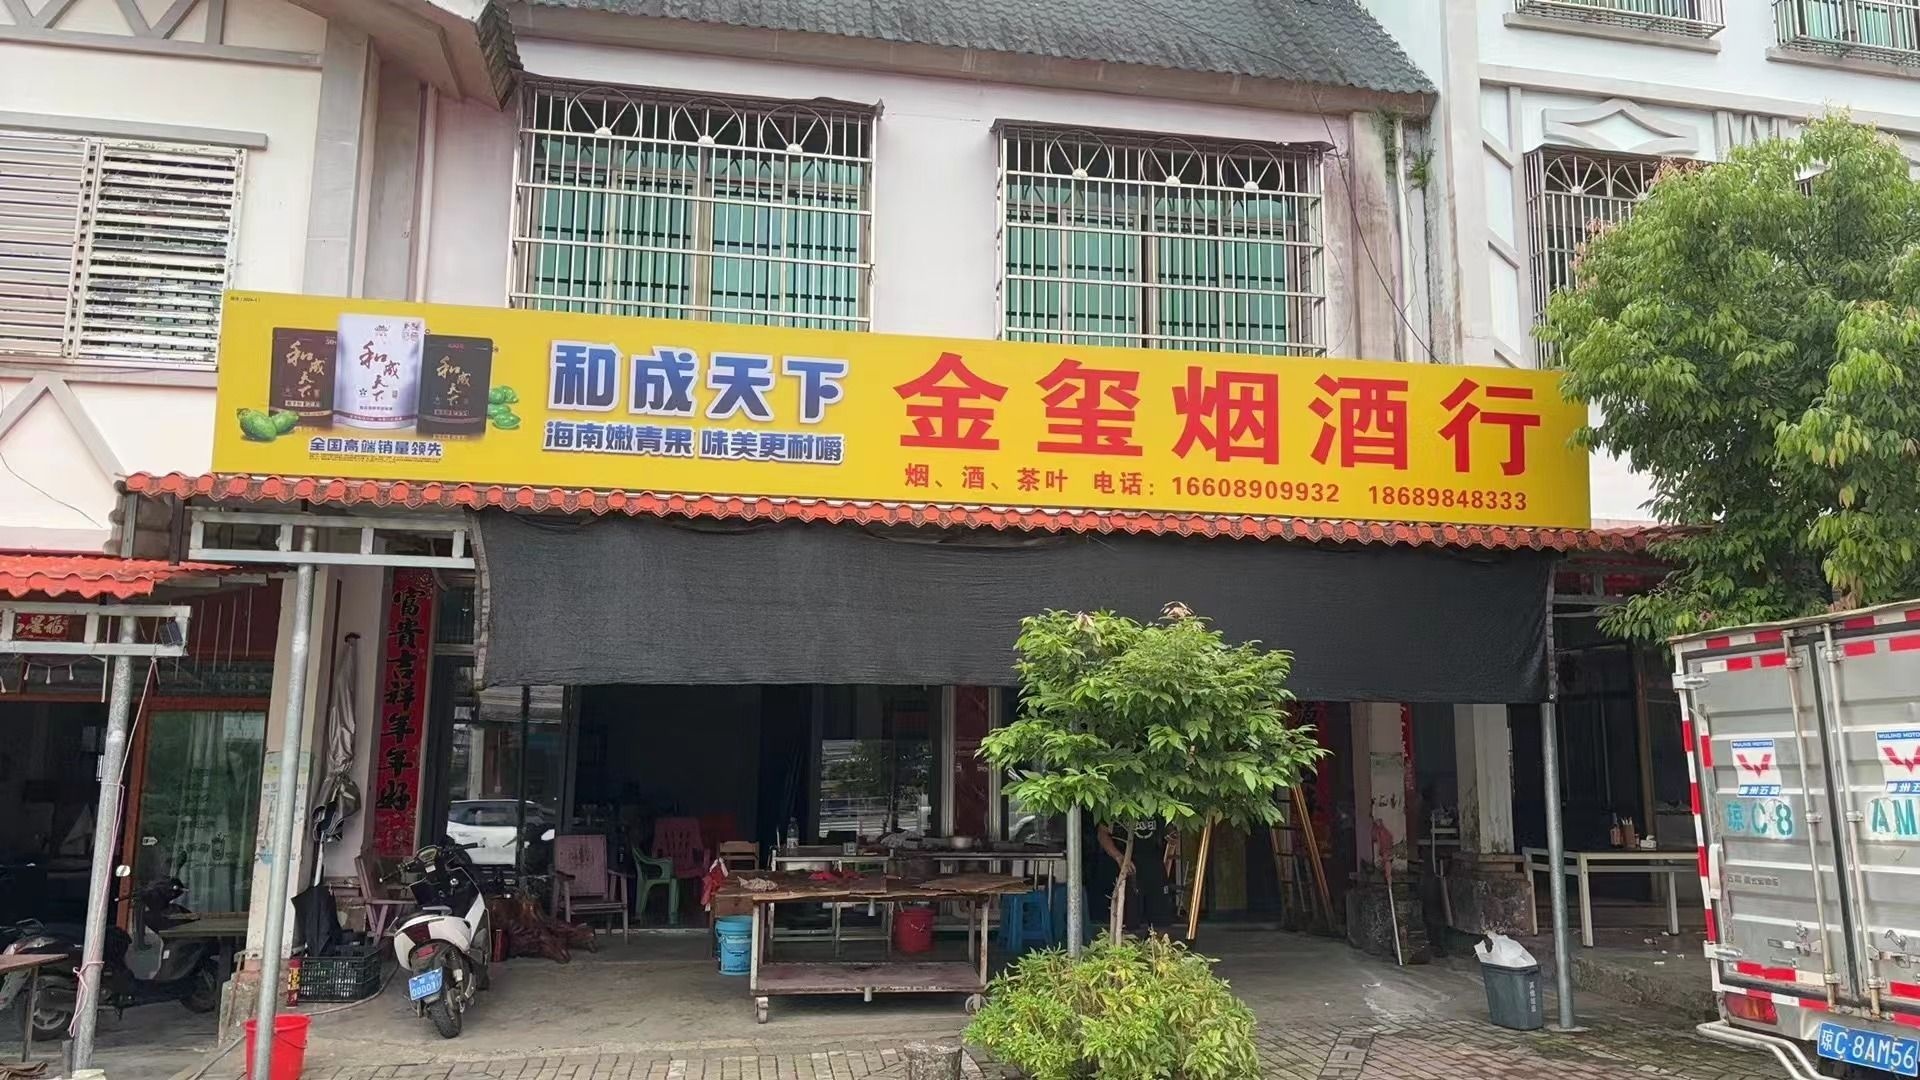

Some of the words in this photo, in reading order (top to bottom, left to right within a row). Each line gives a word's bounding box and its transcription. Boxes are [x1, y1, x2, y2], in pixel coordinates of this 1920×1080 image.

[551, 341, 847, 421] 和成天下
[893, 352, 1540, 475] 金玺烟酒行
[310, 437, 442, 457] 全国高端销量领先
[545, 421, 692, 454] 海南嫩青果
[701, 430, 843, 463] 味美更耐嚼
[1172, 476, 1339, 503] 16608909932
[1368, 485, 1527, 511] 18689848333
